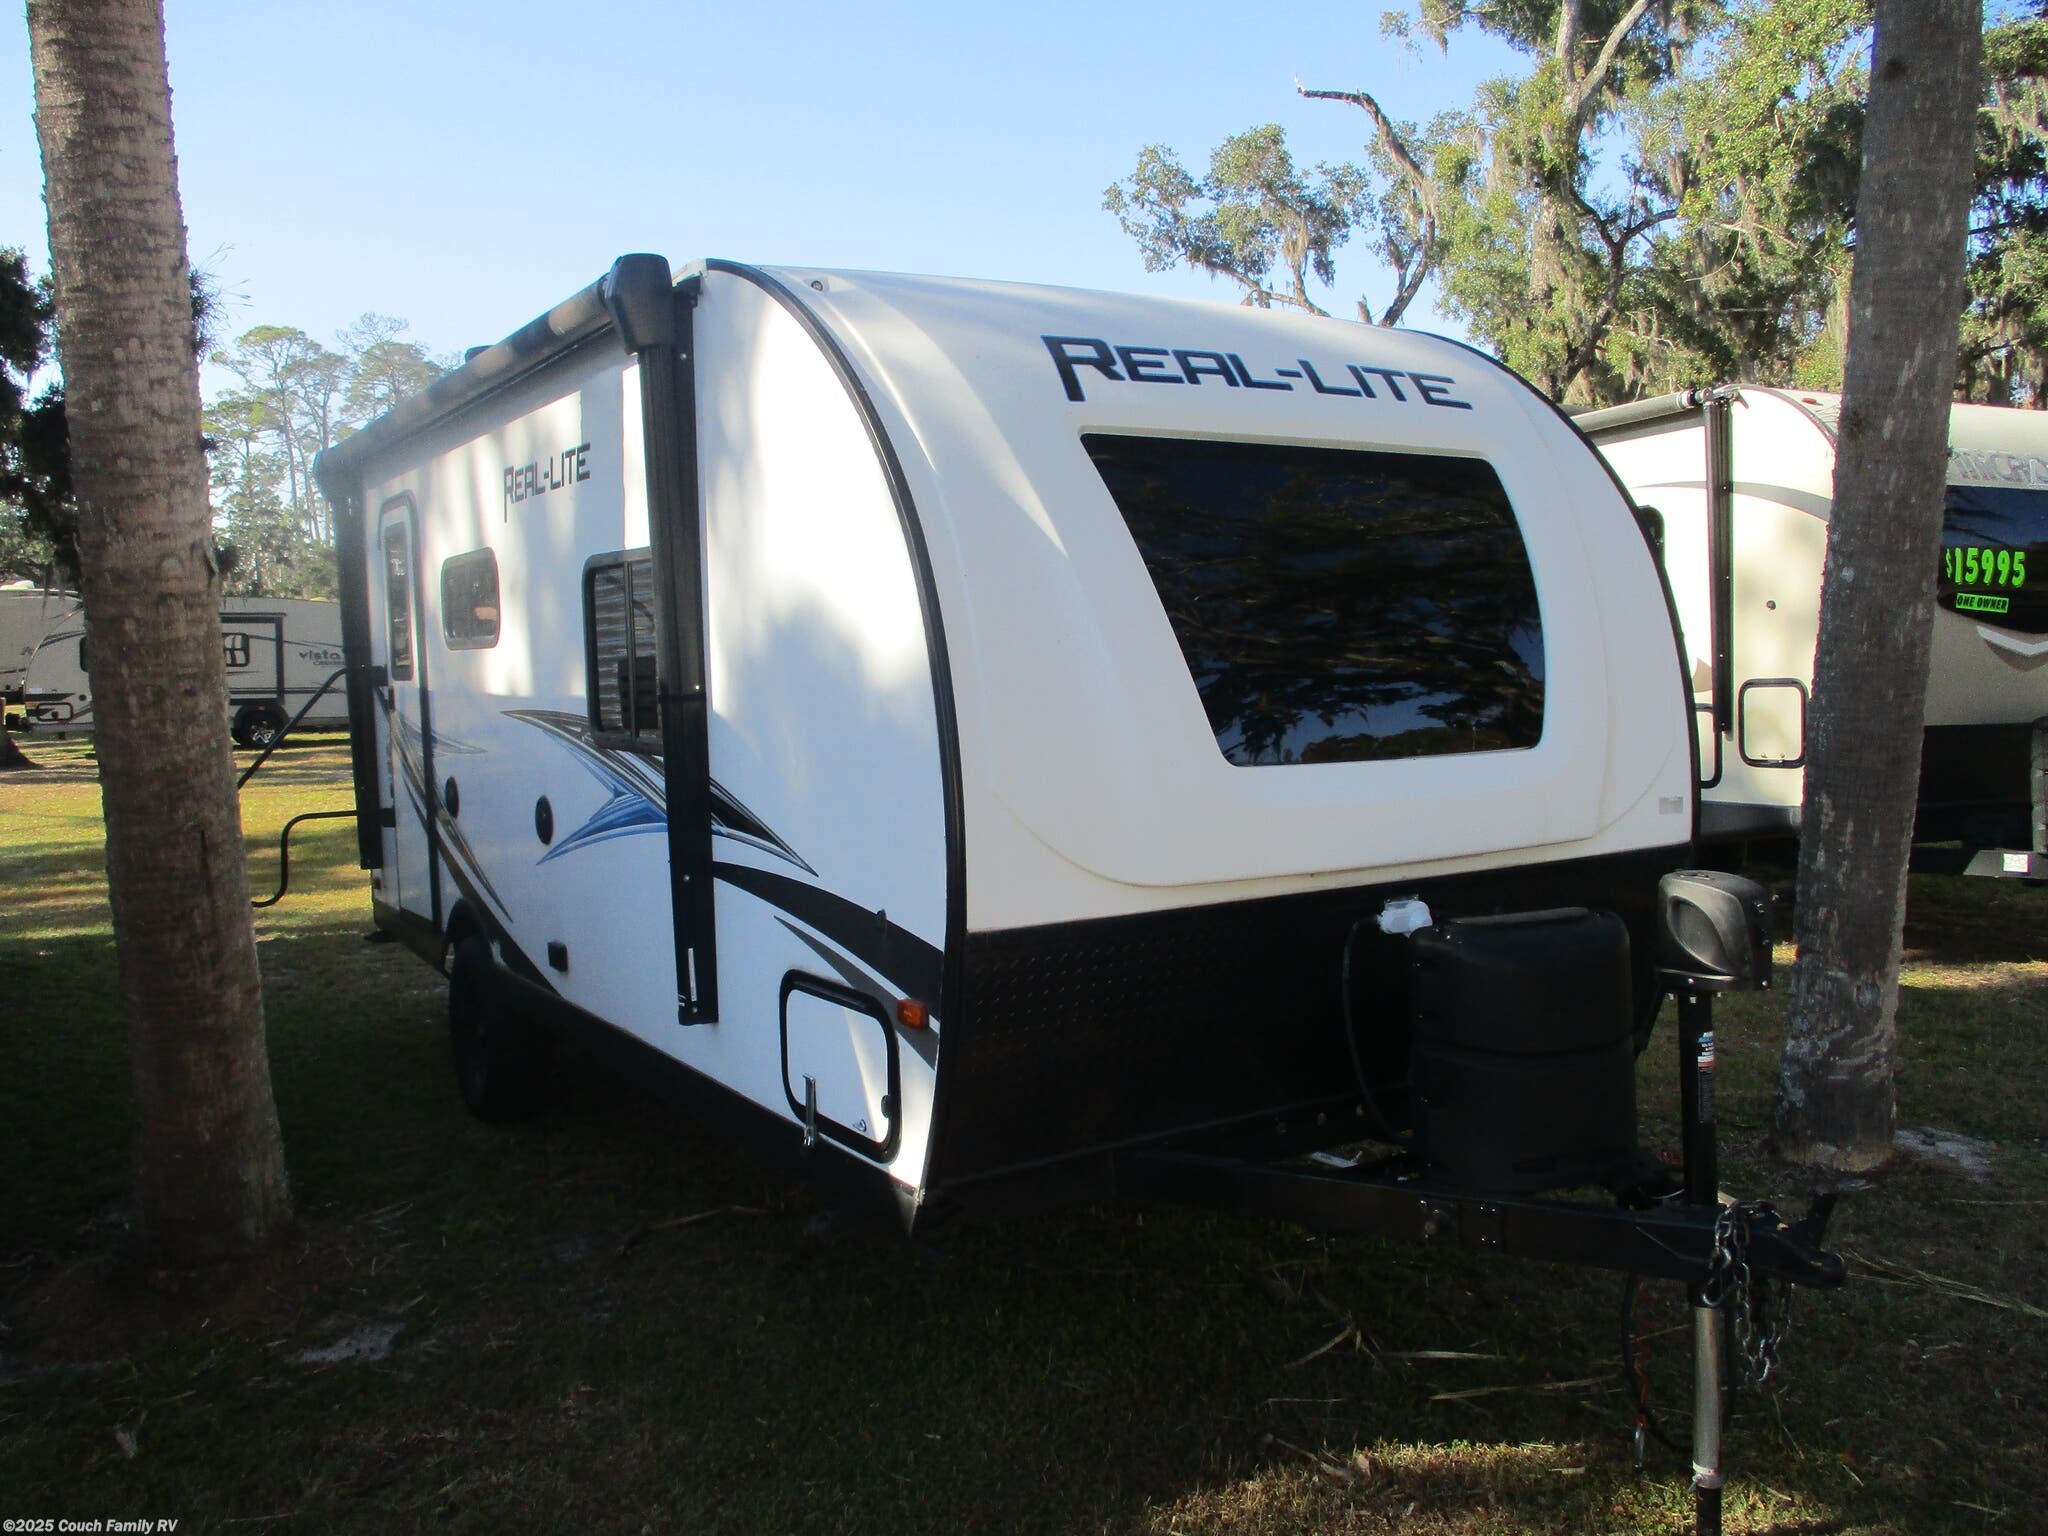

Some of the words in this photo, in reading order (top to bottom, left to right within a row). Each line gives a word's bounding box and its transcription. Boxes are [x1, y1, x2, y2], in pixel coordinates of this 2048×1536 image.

[1040, 334, 1474, 410] REAL-LITE
[503, 441, 591, 523] REAL-LITE
[1945, 547, 2026, 588] $15995
[1957, 594, 1975, 607] ONE
[1976, 597, 2008, 611] OWNER
